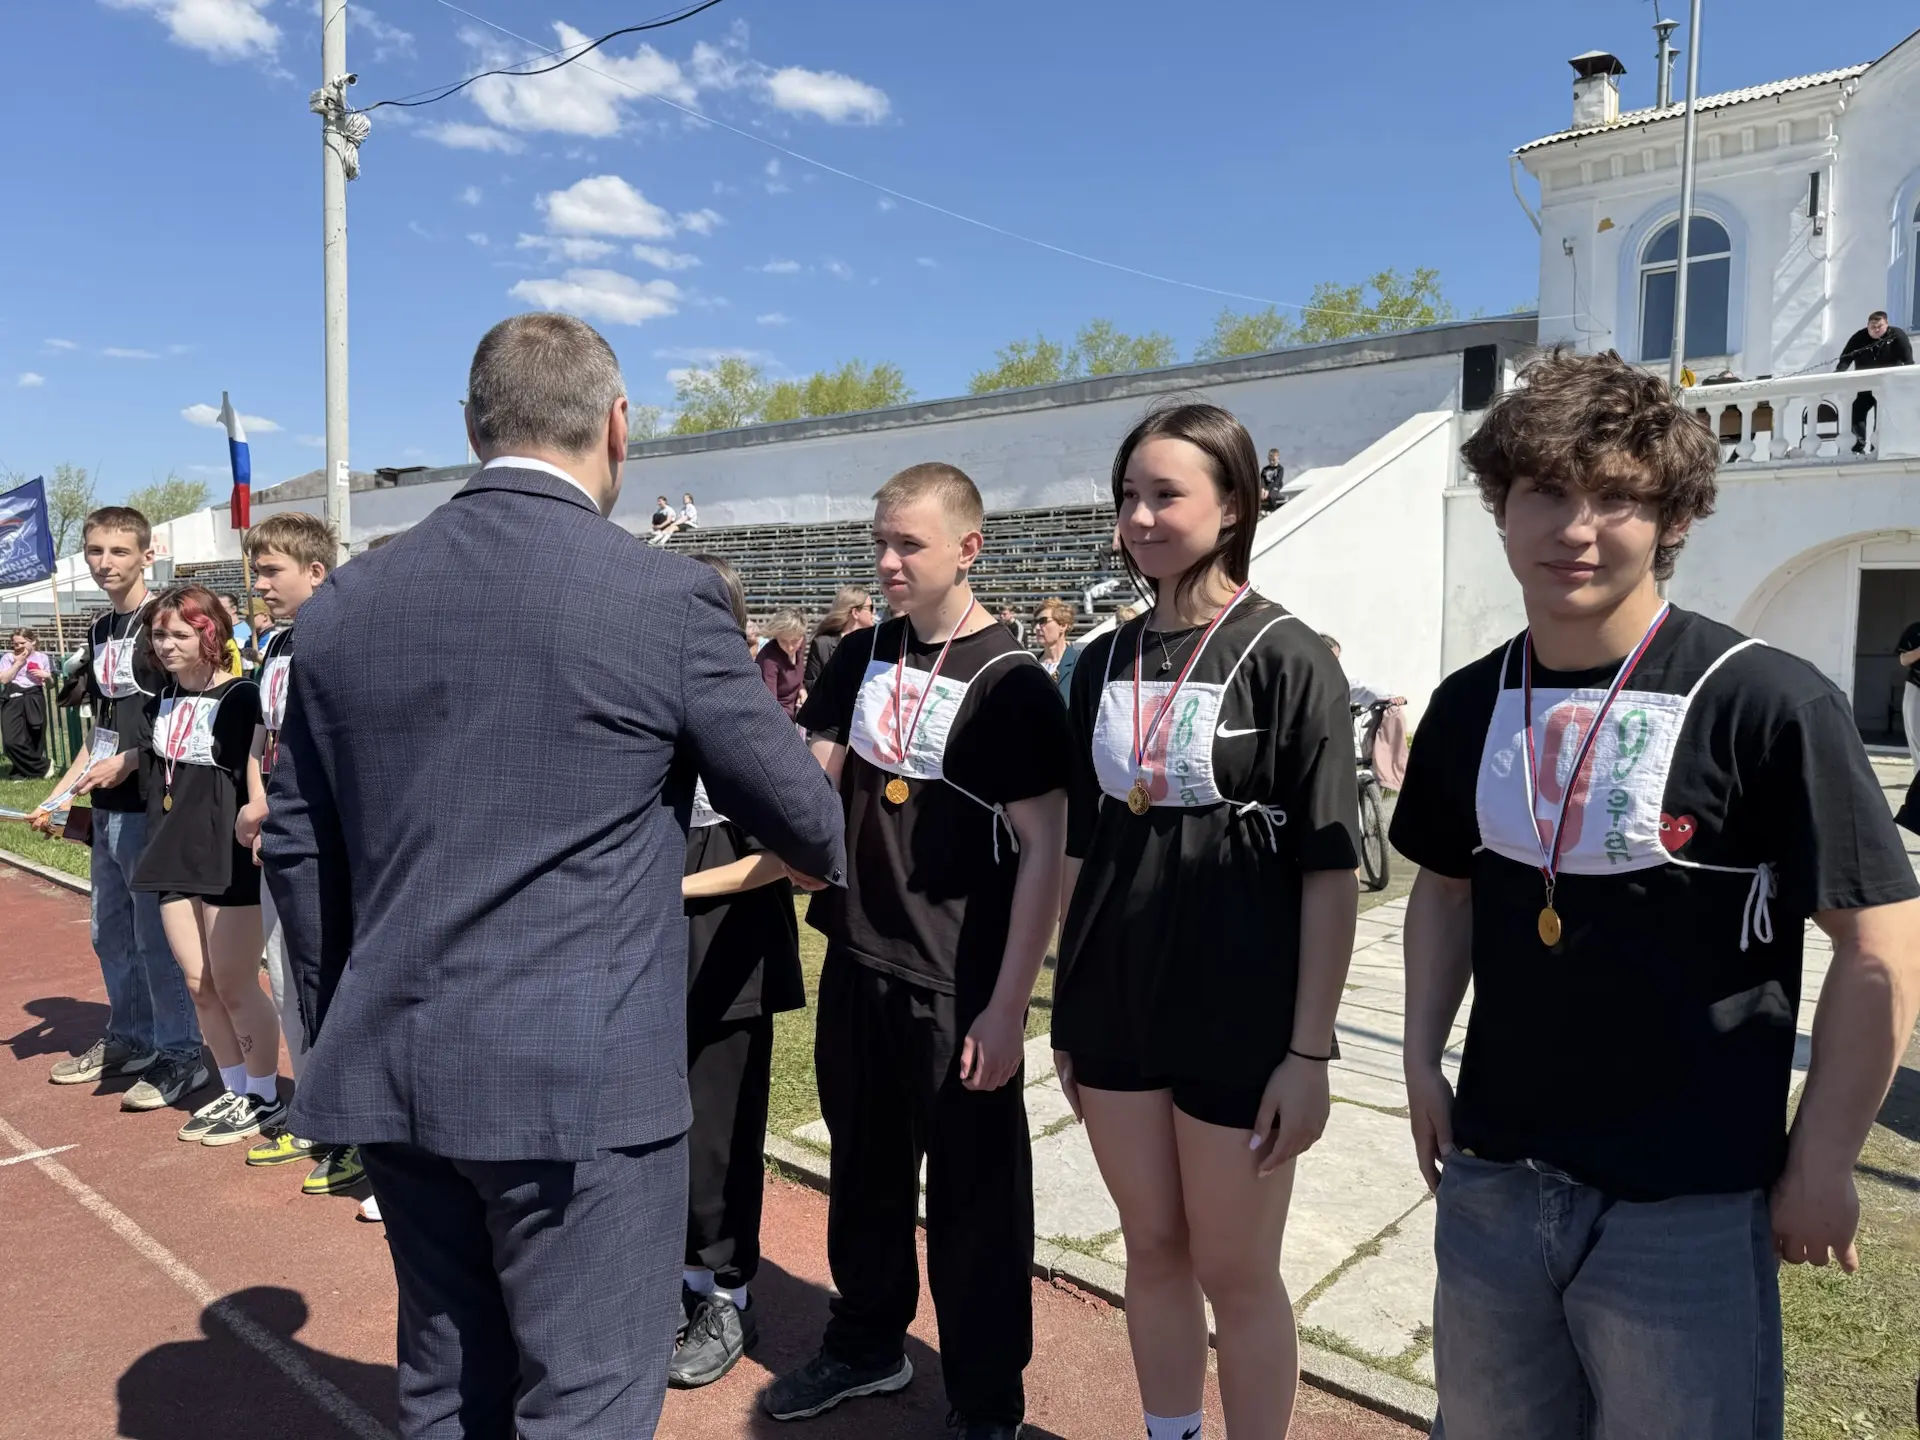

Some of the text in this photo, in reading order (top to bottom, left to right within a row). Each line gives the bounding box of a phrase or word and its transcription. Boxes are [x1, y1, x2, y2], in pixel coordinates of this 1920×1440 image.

[195, 702, 212, 730] 2
[1174, 696, 1199, 751] 8
[1612, 708, 1648, 781] 9
[1537, 705, 1597, 854] 9
